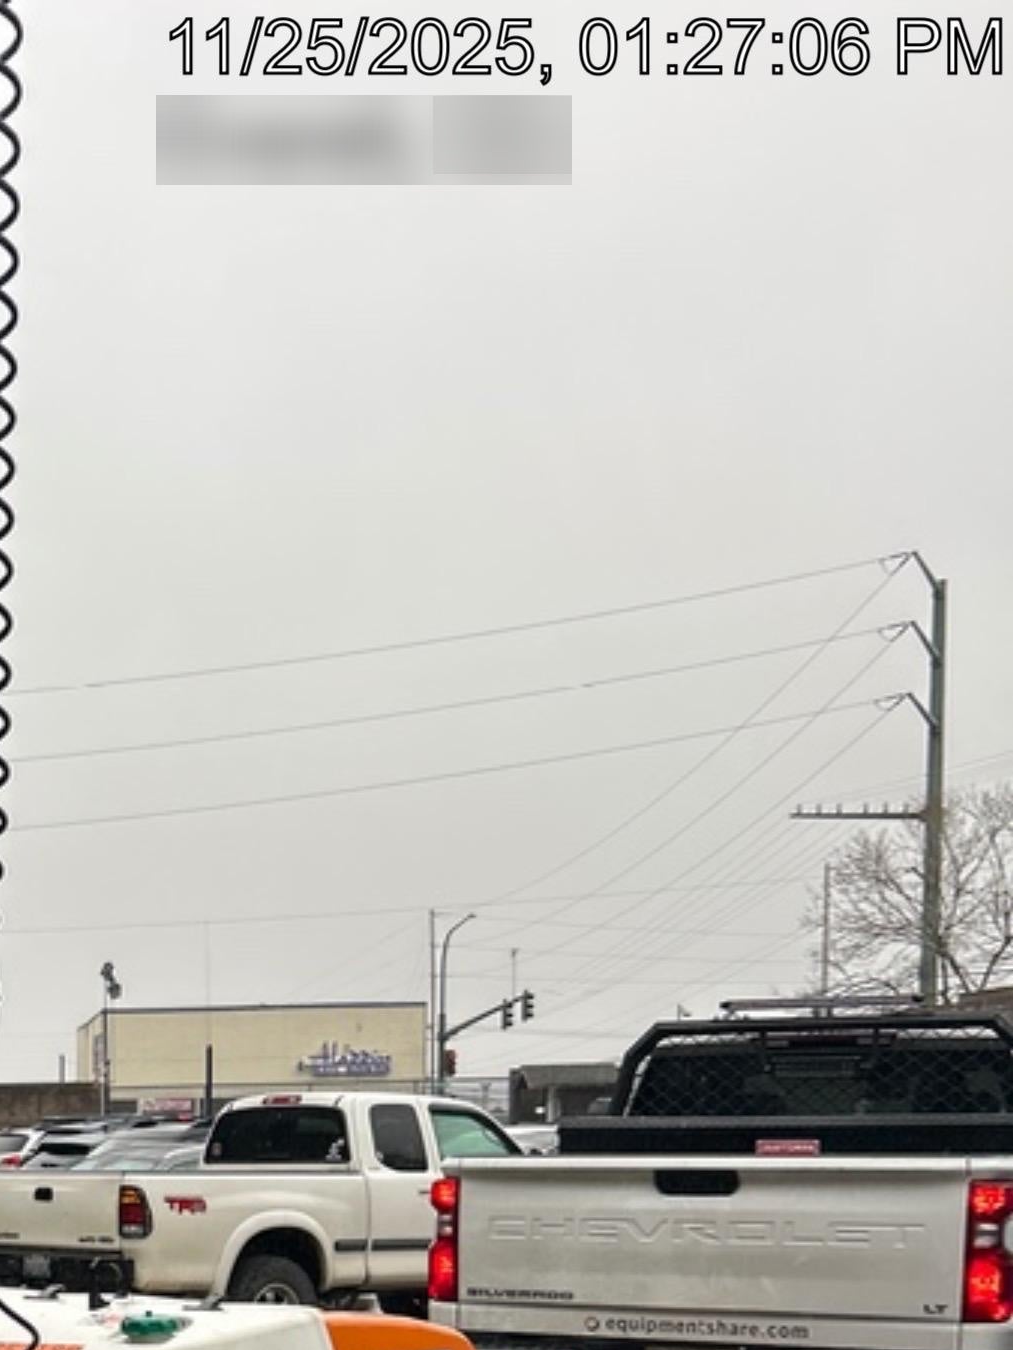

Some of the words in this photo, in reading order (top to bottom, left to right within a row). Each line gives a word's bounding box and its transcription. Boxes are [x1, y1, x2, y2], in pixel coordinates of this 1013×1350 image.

[490, 1217, 926, 1250] CHEVROLET
[466, 1288, 573, 1300] SILVERADO
[923, 1304, 948, 1315] LT
[605, 1316, 810, 1340] equipmentshare.com
